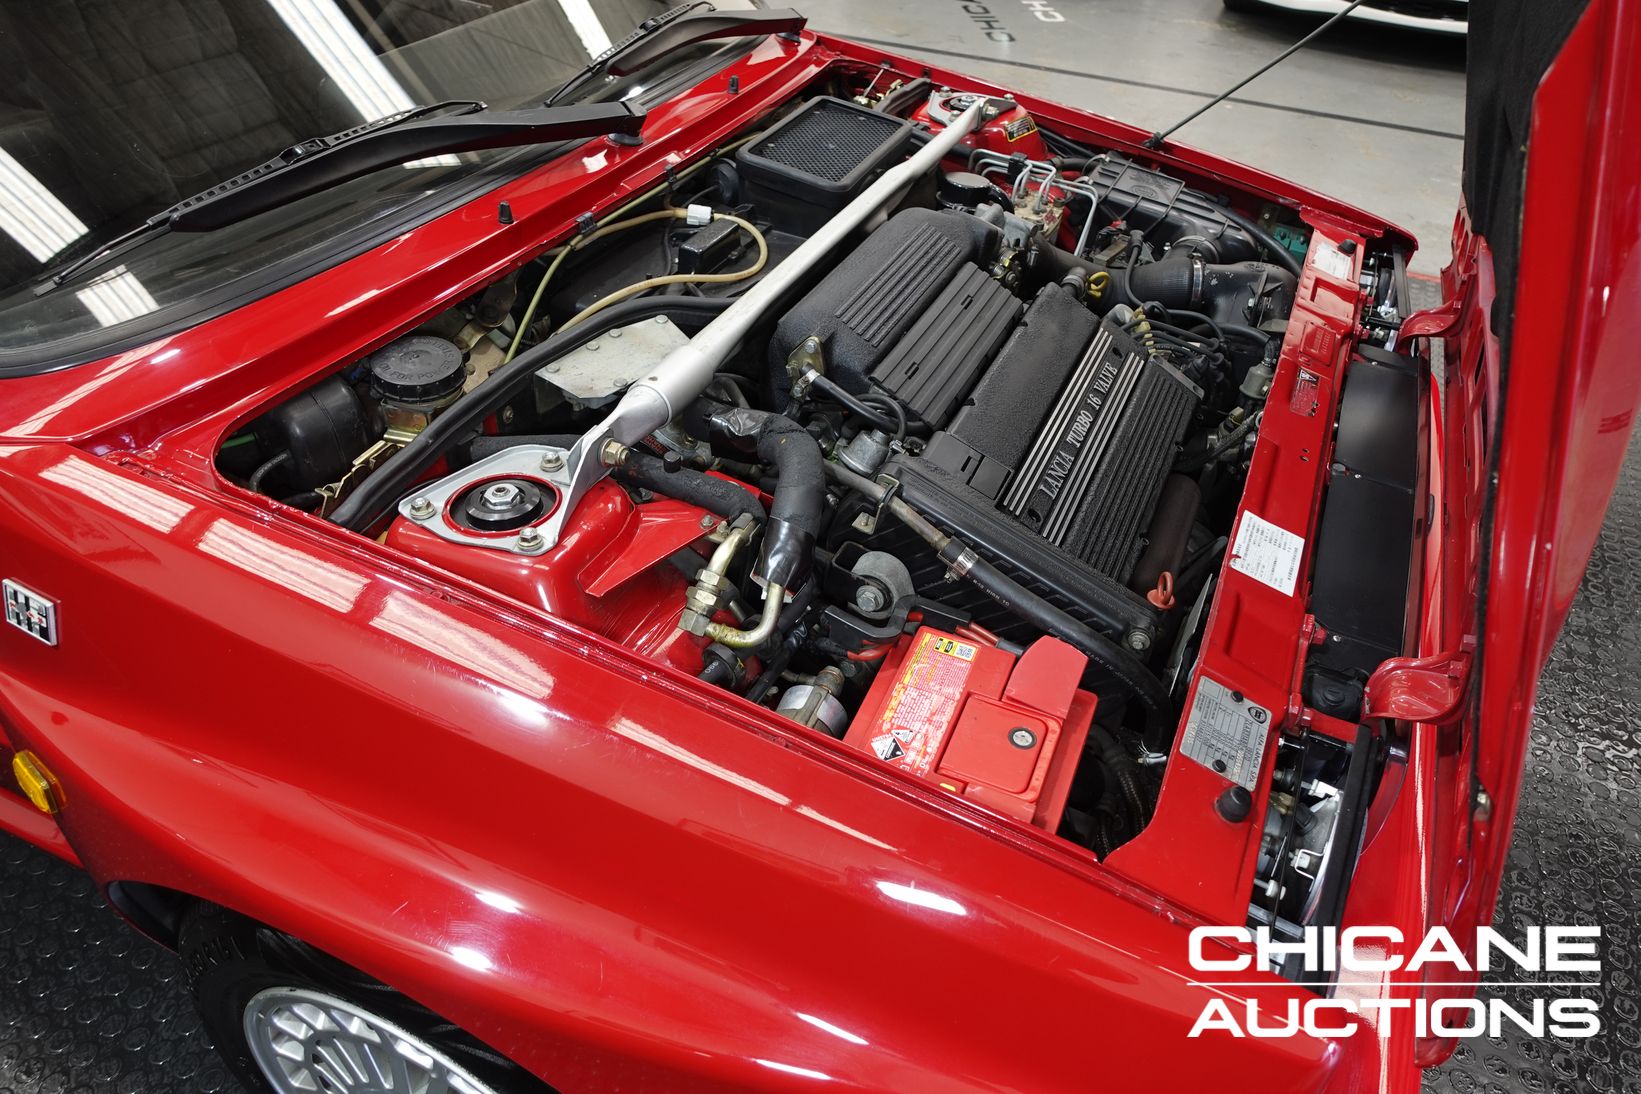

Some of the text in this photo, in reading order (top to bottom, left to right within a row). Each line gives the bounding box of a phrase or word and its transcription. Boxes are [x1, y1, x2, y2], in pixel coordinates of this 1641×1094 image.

[1040, 362, 1118, 499] LANCIA TURBO 16 VALVE
[1253, 747, 1263, 769] LANCIA
